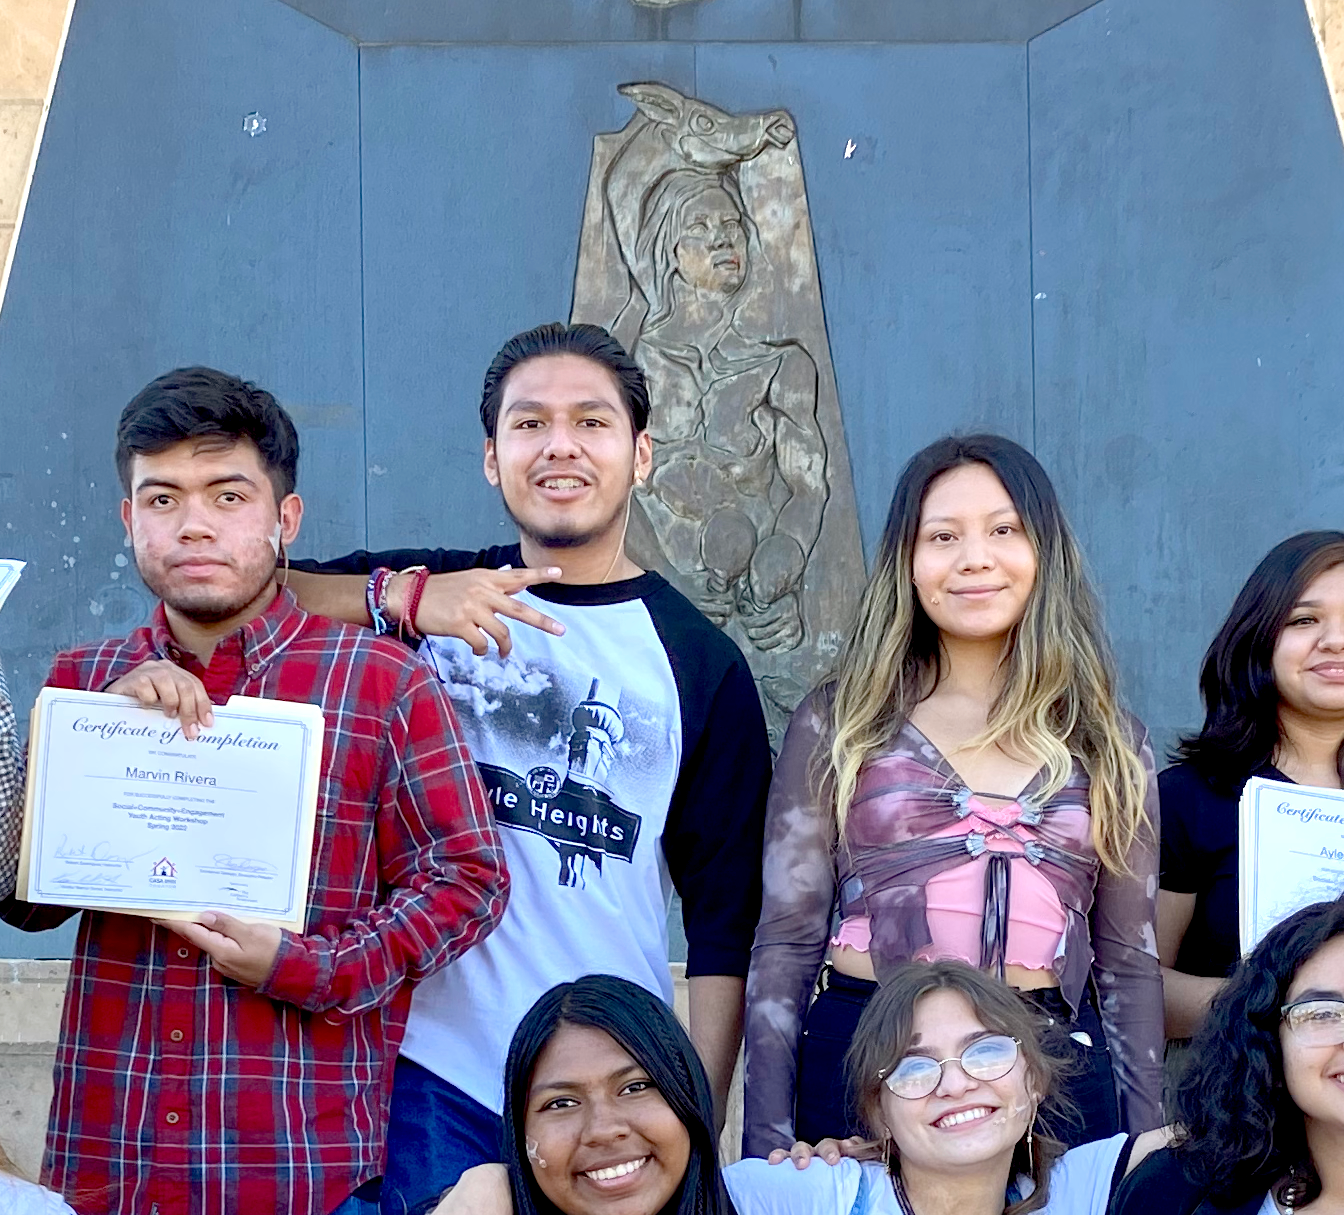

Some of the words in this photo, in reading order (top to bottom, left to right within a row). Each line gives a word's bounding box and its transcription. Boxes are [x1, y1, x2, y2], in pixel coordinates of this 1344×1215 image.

[72, 718, 157, 740] Certificate
[159, 727, 183, 744] of
[185, 733, 280, 750] ompletion
[125, 766, 170, 782] Marvin
[174, 770, 217, 787] Rivera
[531, 799, 625, 841] Heights
